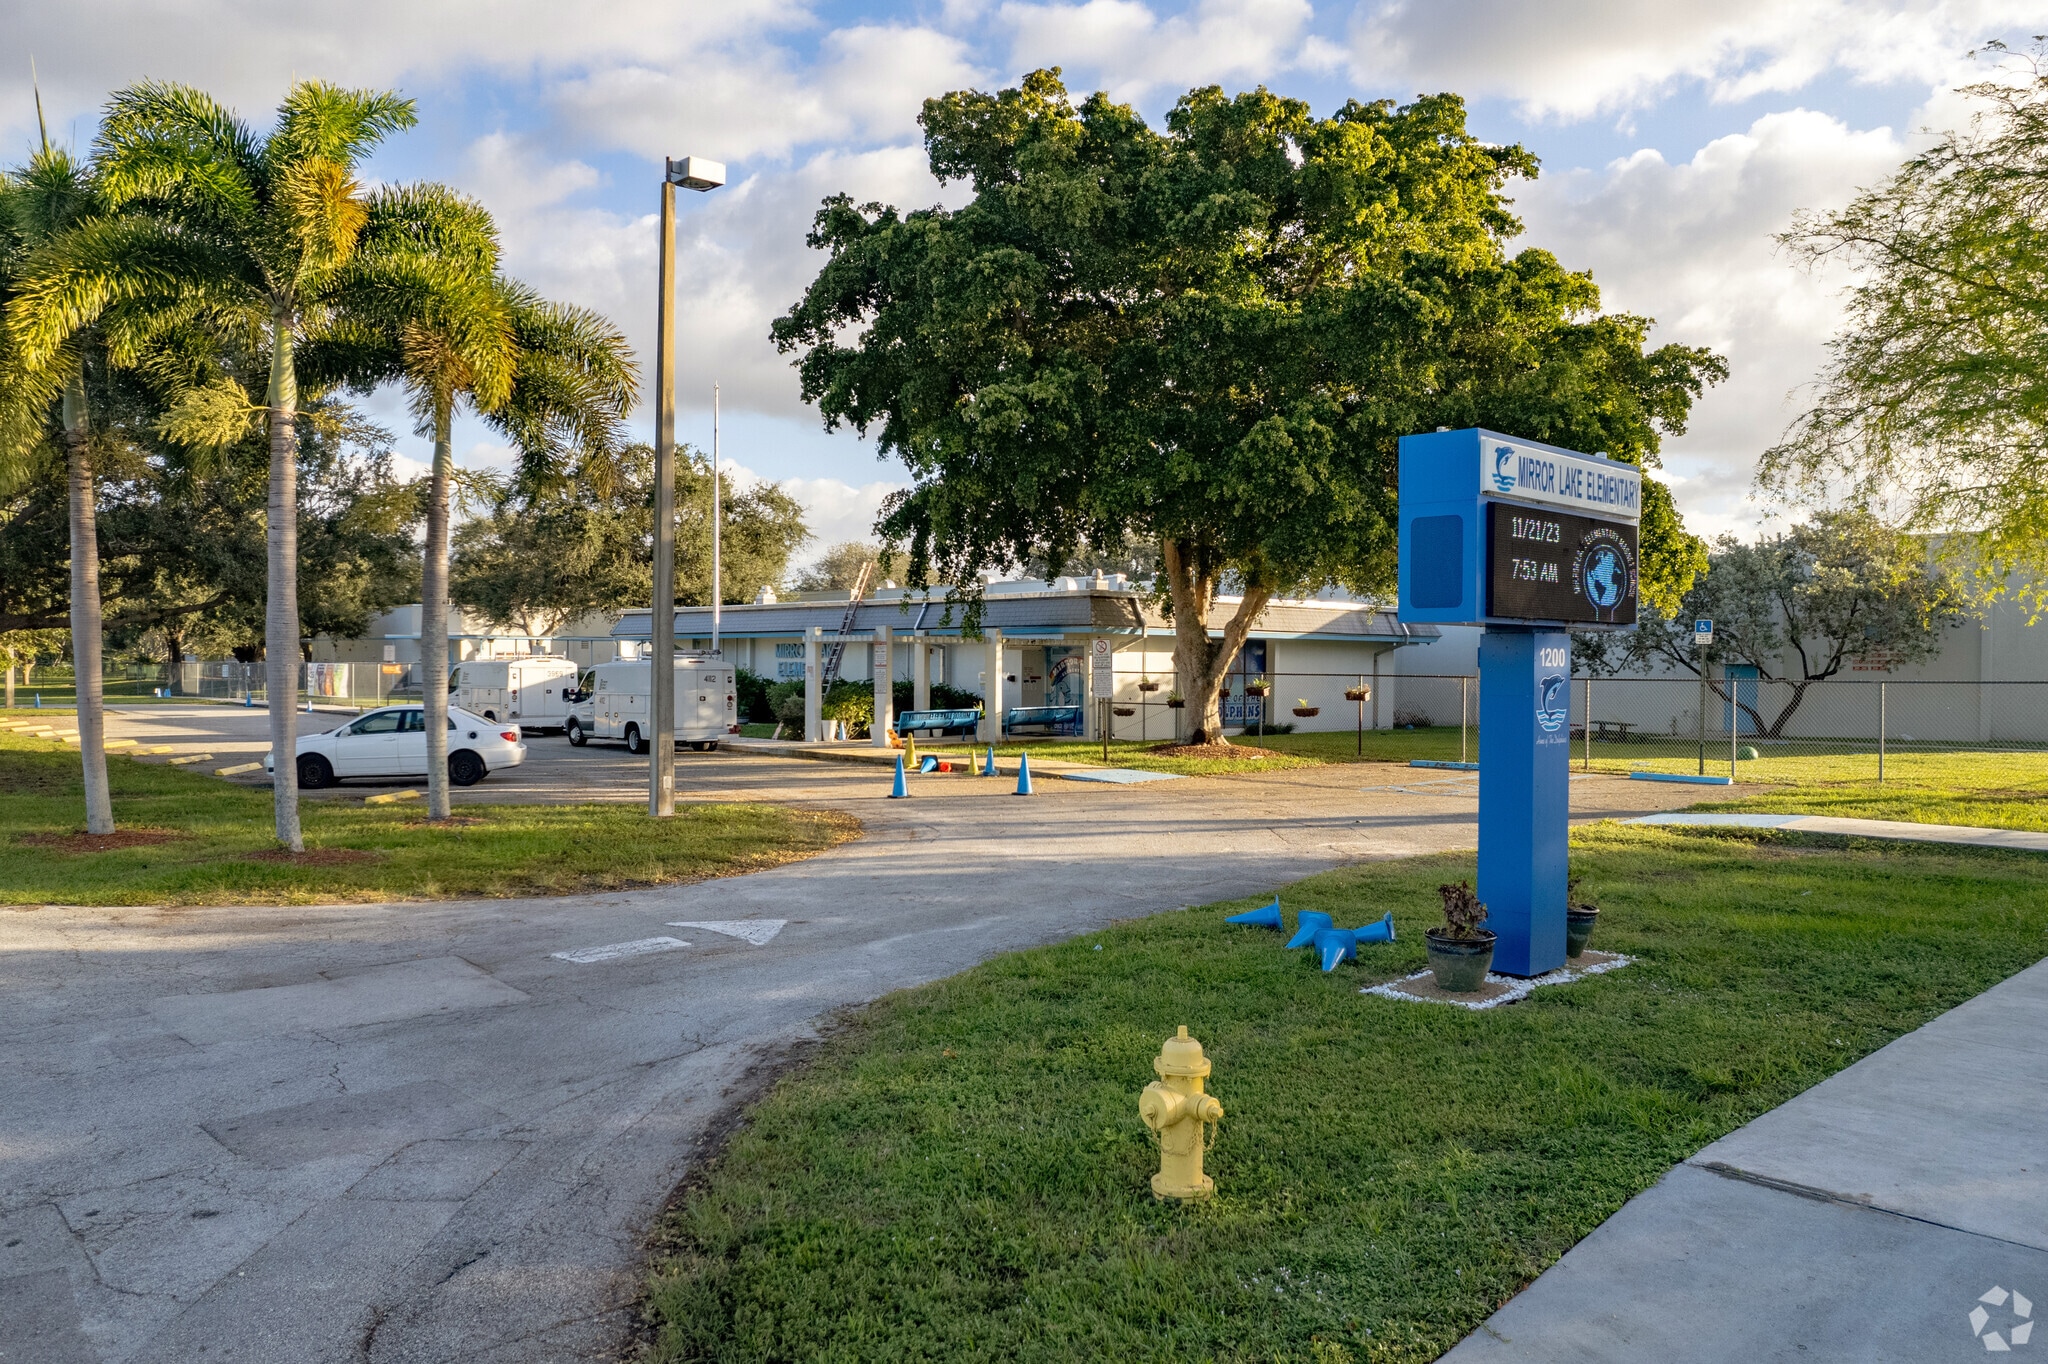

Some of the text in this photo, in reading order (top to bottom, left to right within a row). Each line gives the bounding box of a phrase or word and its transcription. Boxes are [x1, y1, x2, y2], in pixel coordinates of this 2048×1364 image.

[1518, 456, 1640, 510] MIRROR LAKE ELEMENTARY
[1512, 516, 1560, 543] 11/21/23
[1512, 558, 1558, 583] 7:53 AM
[776, 643, 806, 658] MIRRO
[1540, 647, 1566, 667] 1200
